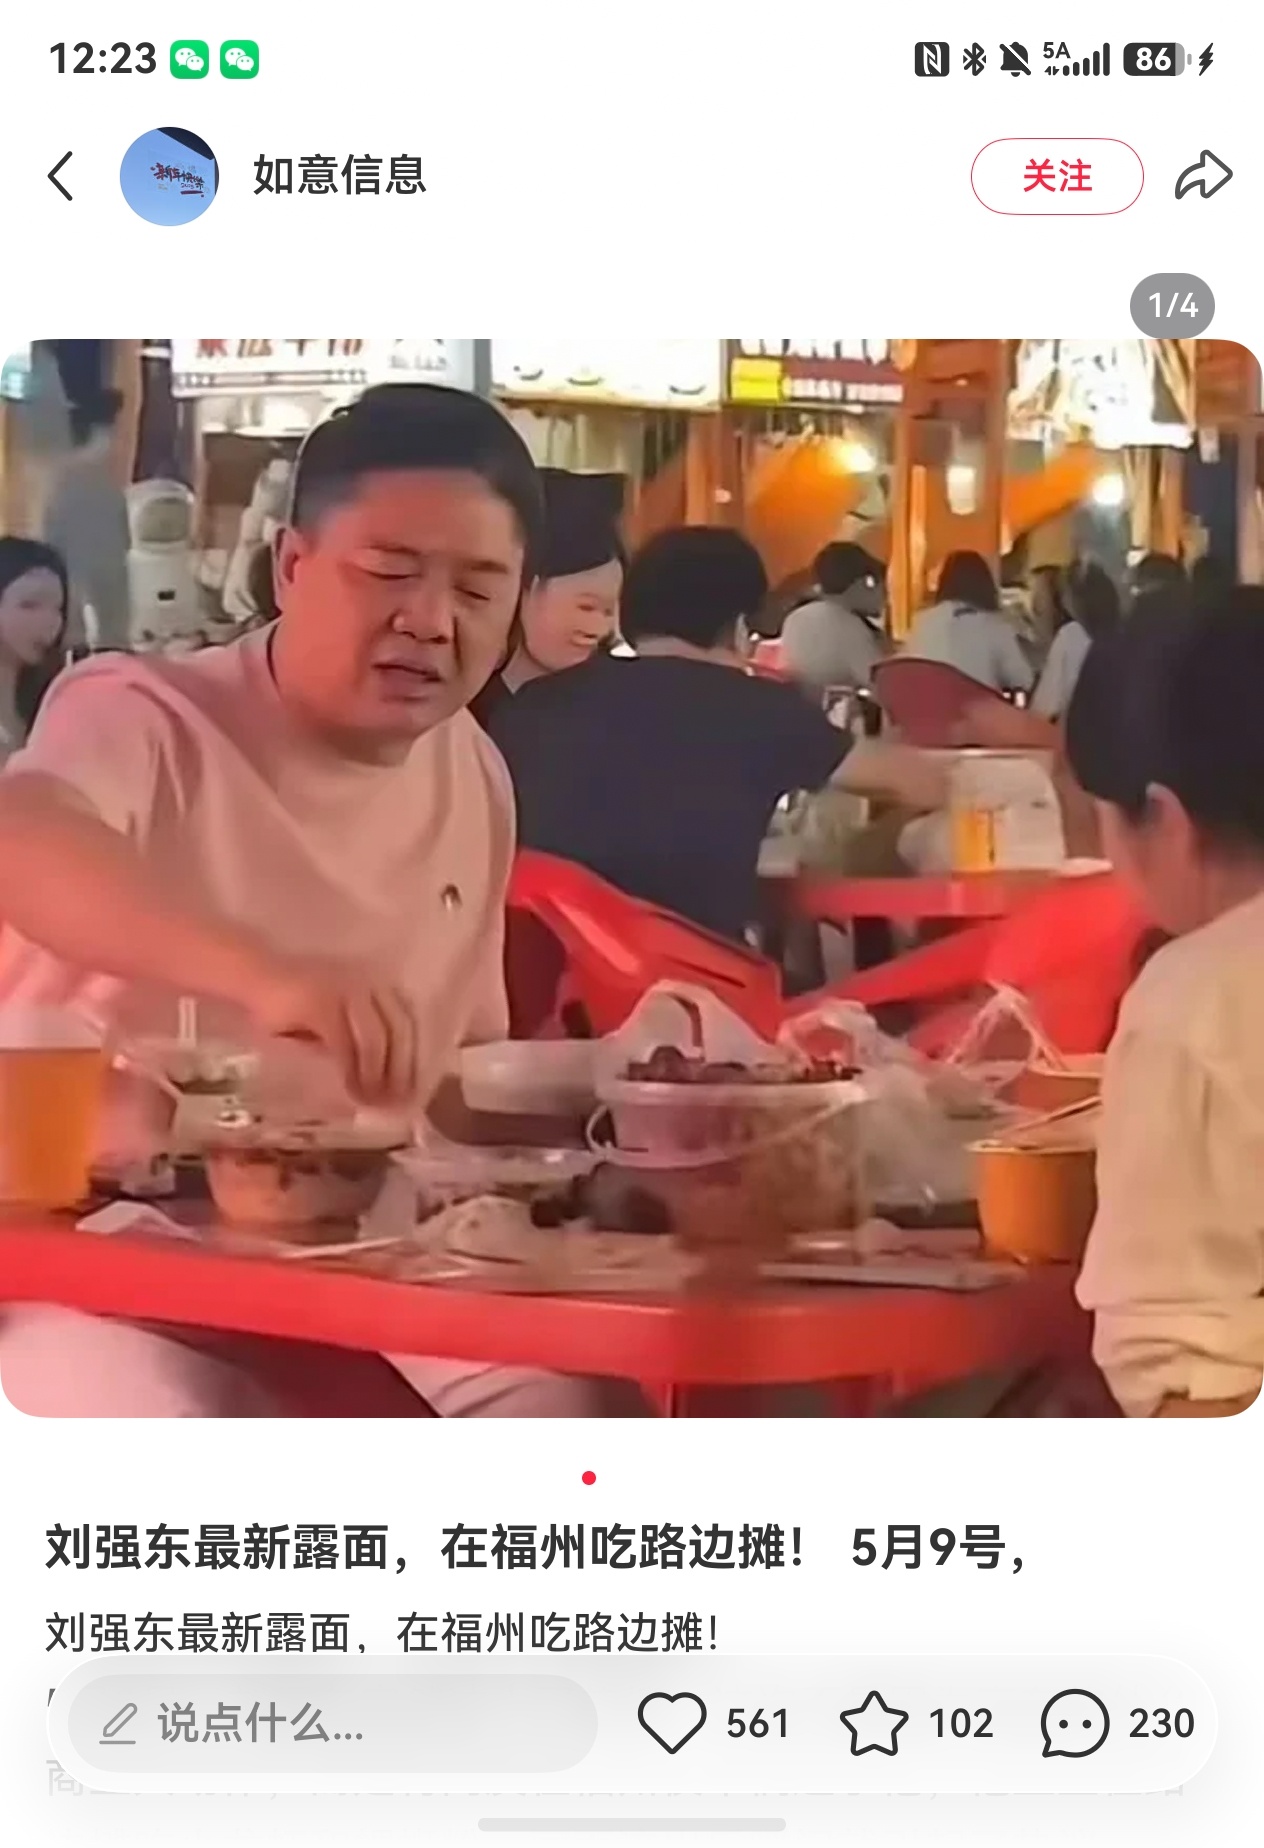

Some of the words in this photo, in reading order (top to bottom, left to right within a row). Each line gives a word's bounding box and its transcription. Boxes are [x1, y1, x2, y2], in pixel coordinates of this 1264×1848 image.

[49, 41, 158, 75] 12:23
[1042, 41, 1072, 60] 5A
[1135, 46, 1172, 72] 86
[252, 153, 428, 196] 如意信息
[1022, 157, 1094, 193] 关注
[1148, 292, 1200, 318] 1/4
[726, 1707, 788, 1740] 561
[928, 1707, 995, 1740] 102
[1128, 1707, 1196, 1740] 230
